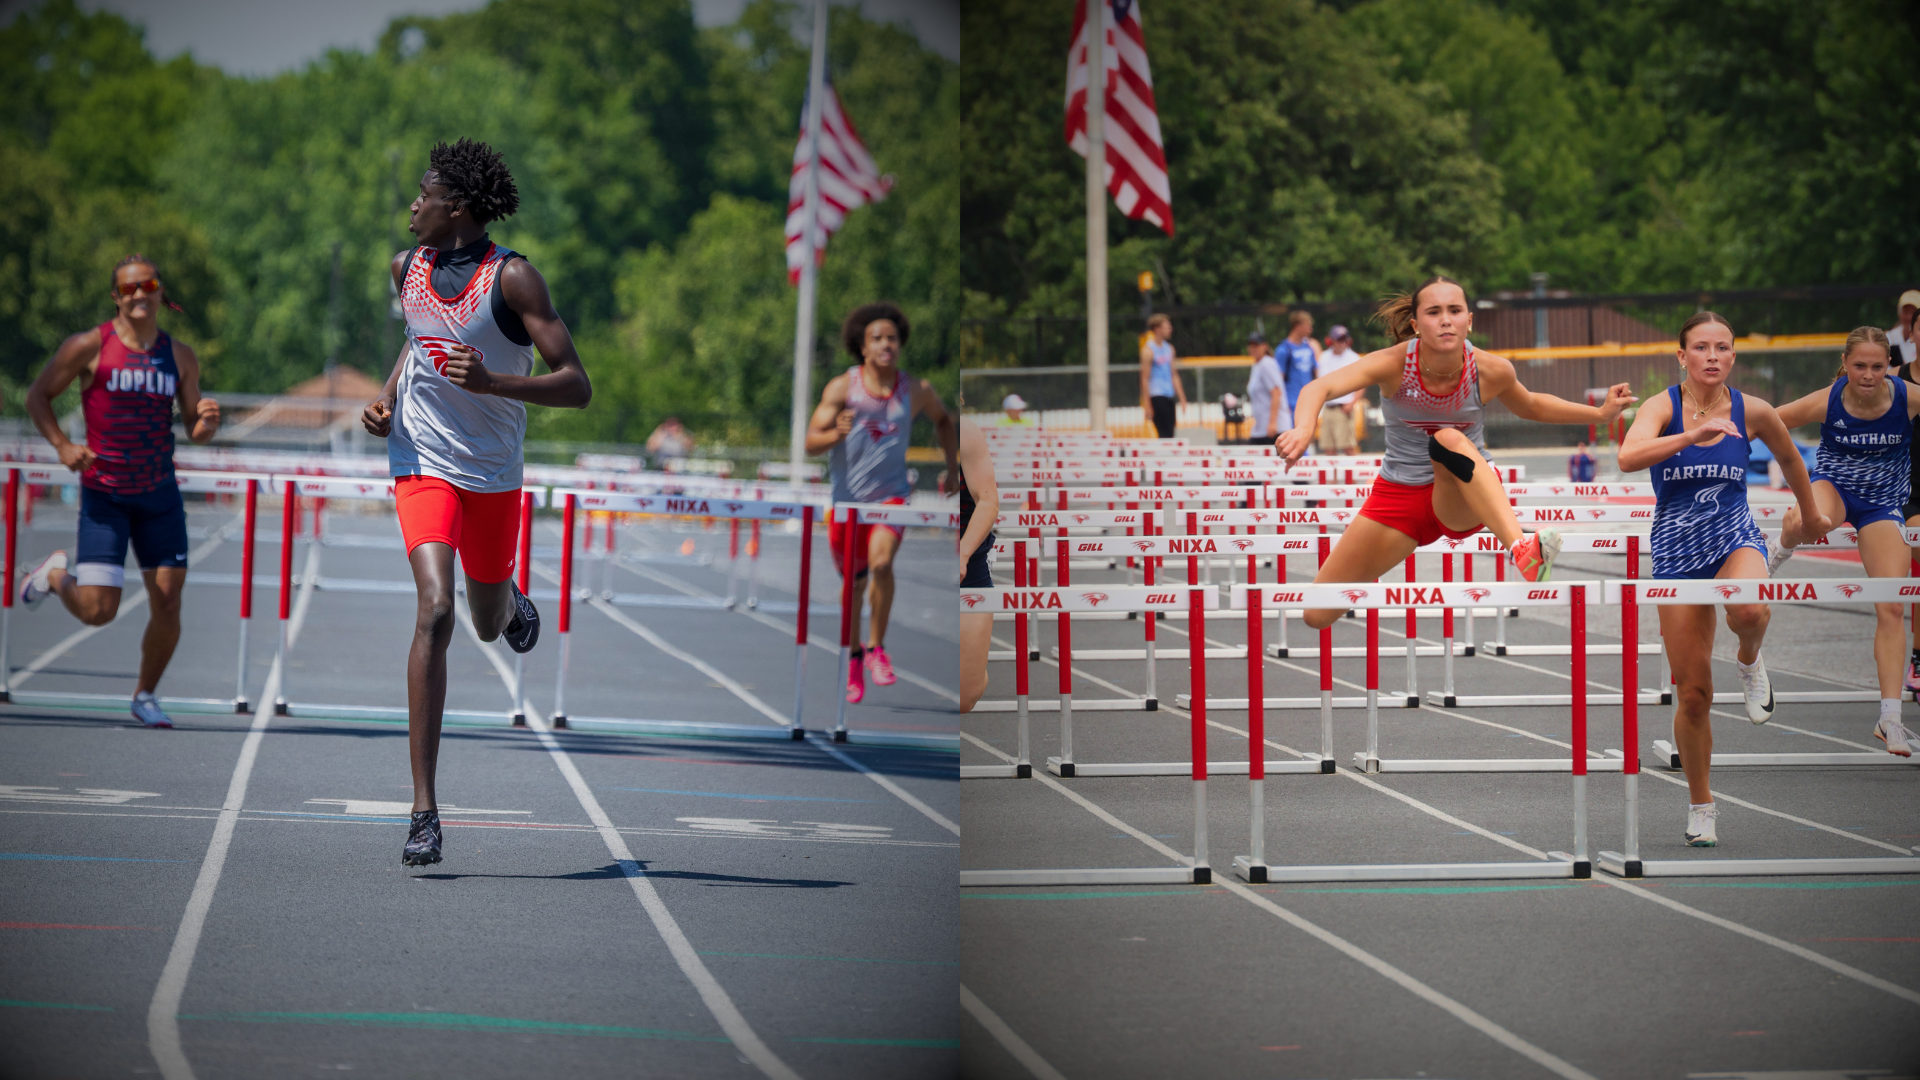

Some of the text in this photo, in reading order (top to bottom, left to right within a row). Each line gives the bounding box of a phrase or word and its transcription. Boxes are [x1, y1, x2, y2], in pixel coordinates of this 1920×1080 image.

[106, 367, 176, 397] JOPLIN
[1834, 432, 1902, 445] CARTHAGE
[1032, 471, 1062, 481] NIXA
[1224, 470, 1255, 480] NIXA
[1663, 464, 1744, 481] CARTHAGE
[1139, 489, 1174, 500] NIXA
[1221, 490, 1239, 498] GILL
[1290, 489, 1309, 497] GILL
[1574, 485, 1609, 496] NIXA
[666, 498, 710, 513] NIXA
[1018, 513, 1136, 526] NIXA GILL
[1203, 511, 1320, 523] GILL NIXA
[1535, 509, 1651, 521] NIXA GILL
[1077, 539, 1309, 553] GILL NIXA GILL
[1592, 539, 1617, 548] GILL
[1272, 588, 1559, 605] GILL NIXA GILL
[1646, 588, 1678, 598] GILL
[1758, 583, 1818, 600] NIXA
[1003, 592, 1177, 609] NIXA GILL
